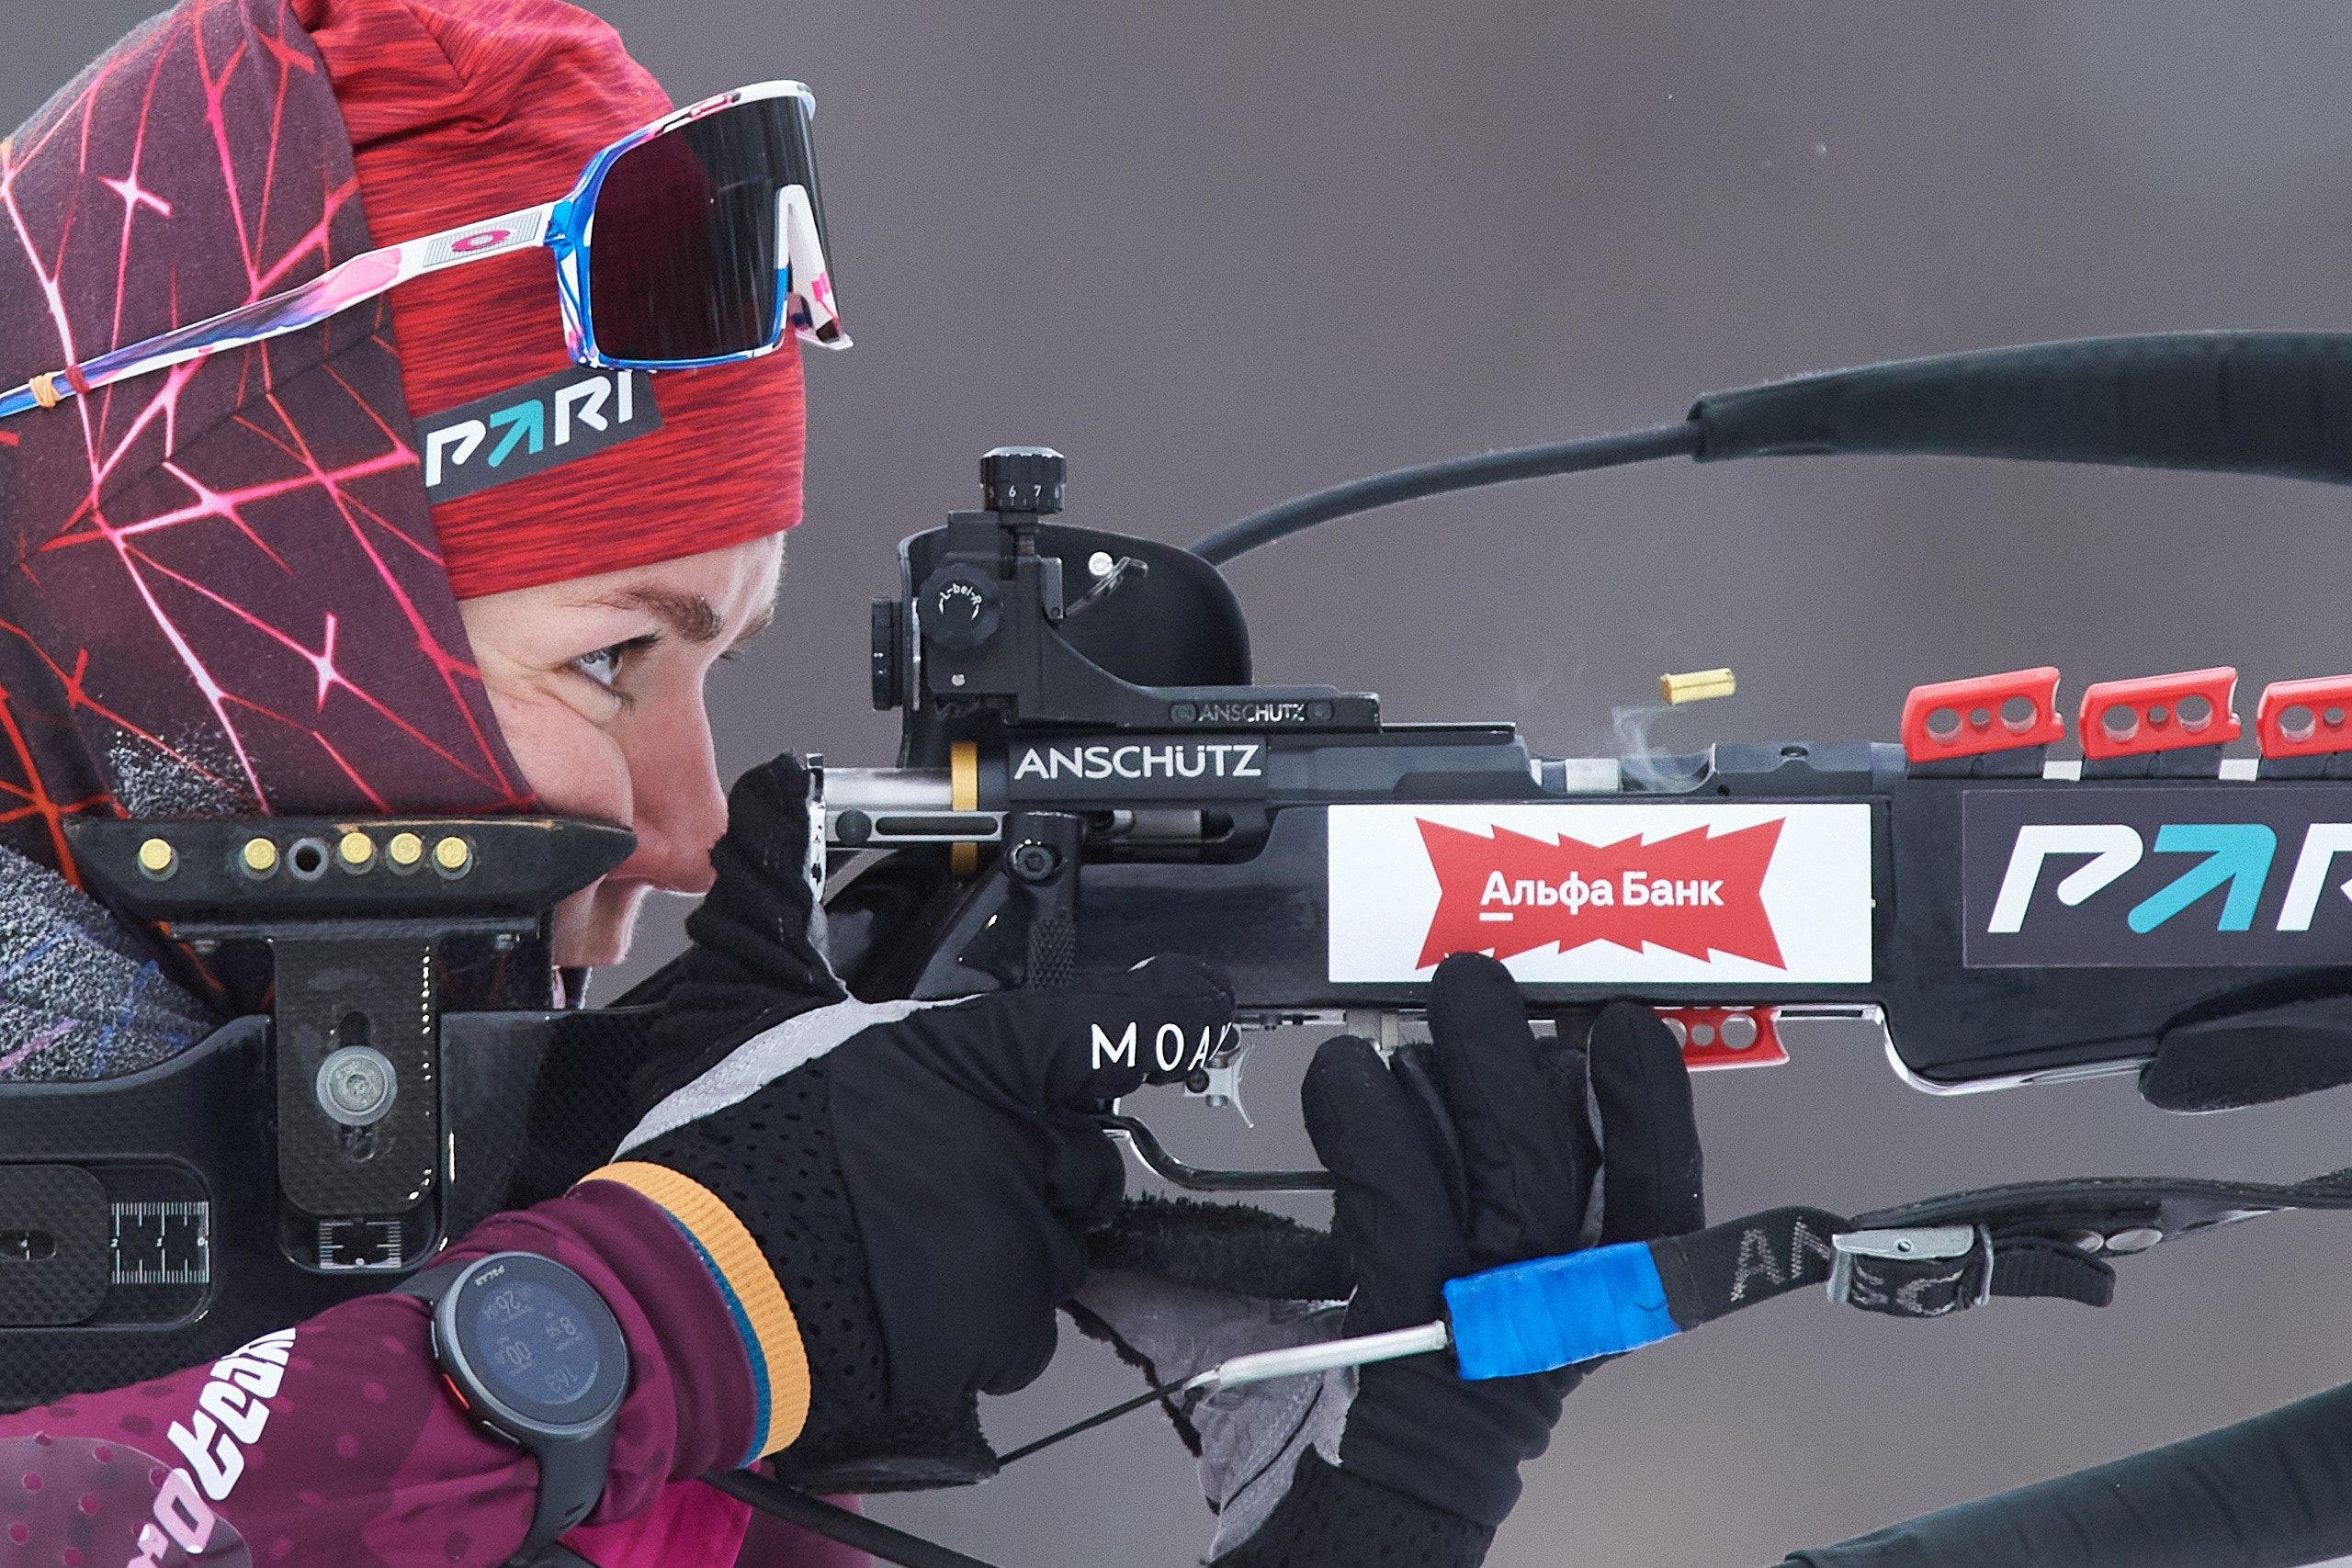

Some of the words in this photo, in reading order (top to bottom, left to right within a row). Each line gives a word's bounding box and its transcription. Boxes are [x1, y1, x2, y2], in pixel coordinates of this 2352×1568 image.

[425, 371, 633, 487] PARI
[1008, 484, 1016, 498] 6
[1034, 484, 1042, 498] 7
[1013, 744, 1261, 780] ANSCHÜTZ
[1478, 870, 1614, 916] Альфа
[1623, 871, 1724, 906] Банк
[110, 1238, 119, 1247] 2
